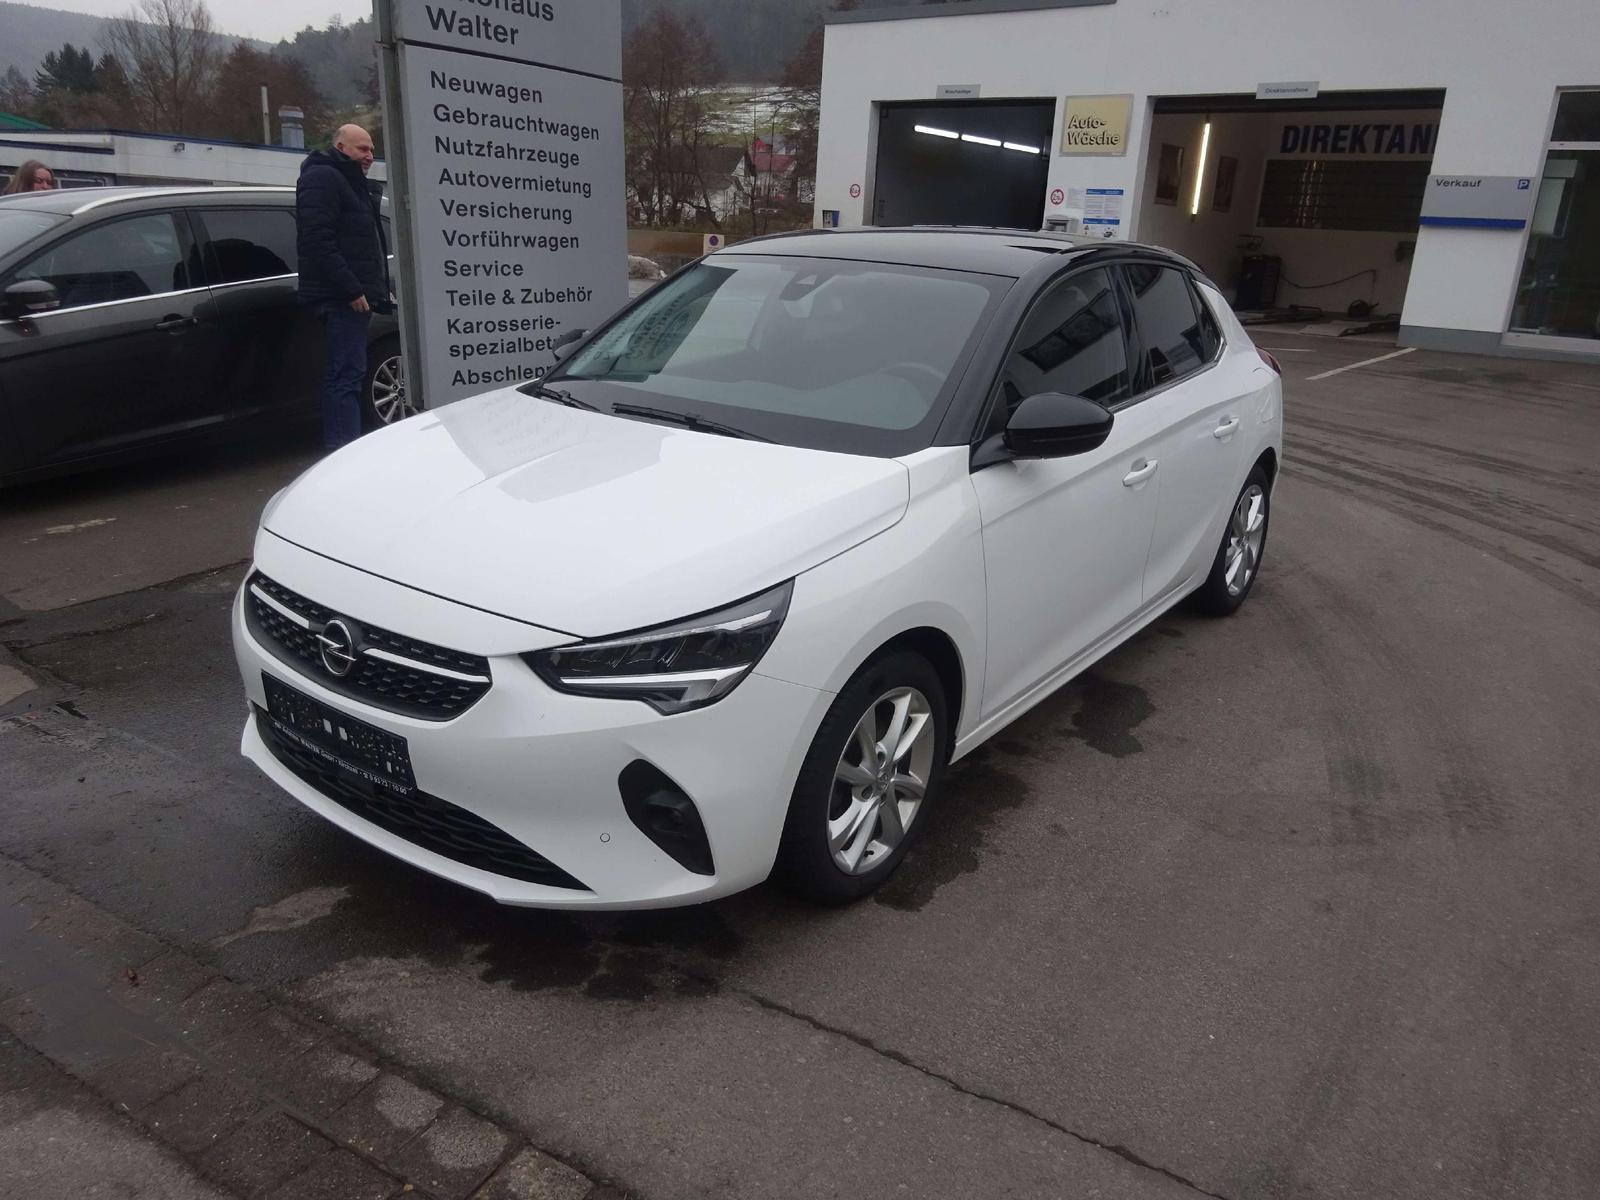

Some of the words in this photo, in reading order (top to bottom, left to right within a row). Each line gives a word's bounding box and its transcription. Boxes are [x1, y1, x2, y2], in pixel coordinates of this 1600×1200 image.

[425, 5, 519, 45] Walter
[430, 70, 542, 103] Neuwagen
[433, 103, 600, 142] Gebrauchtwagen
[1068, 115, 1107, 129] Auto-
[1067, 130, 1120, 146] Wäsche
[435, 135, 580, 169] Nutzfahrzeuge
[438, 168, 592, 198] Autovermietung
[1435, 178, 1482, 188] Verkauf
[440, 198, 572, 225] Versicherung
[442, 229, 579, 252] Vorführwagen
[444, 259, 524, 277] Service
[446, 289, 496, 306] Teile
[502, 289, 515, 305] &
[520, 286, 593, 305] Zubehör
[447, 315, 561, 335] Karosserie-
[449, 334, 558, 360] spezialbet
